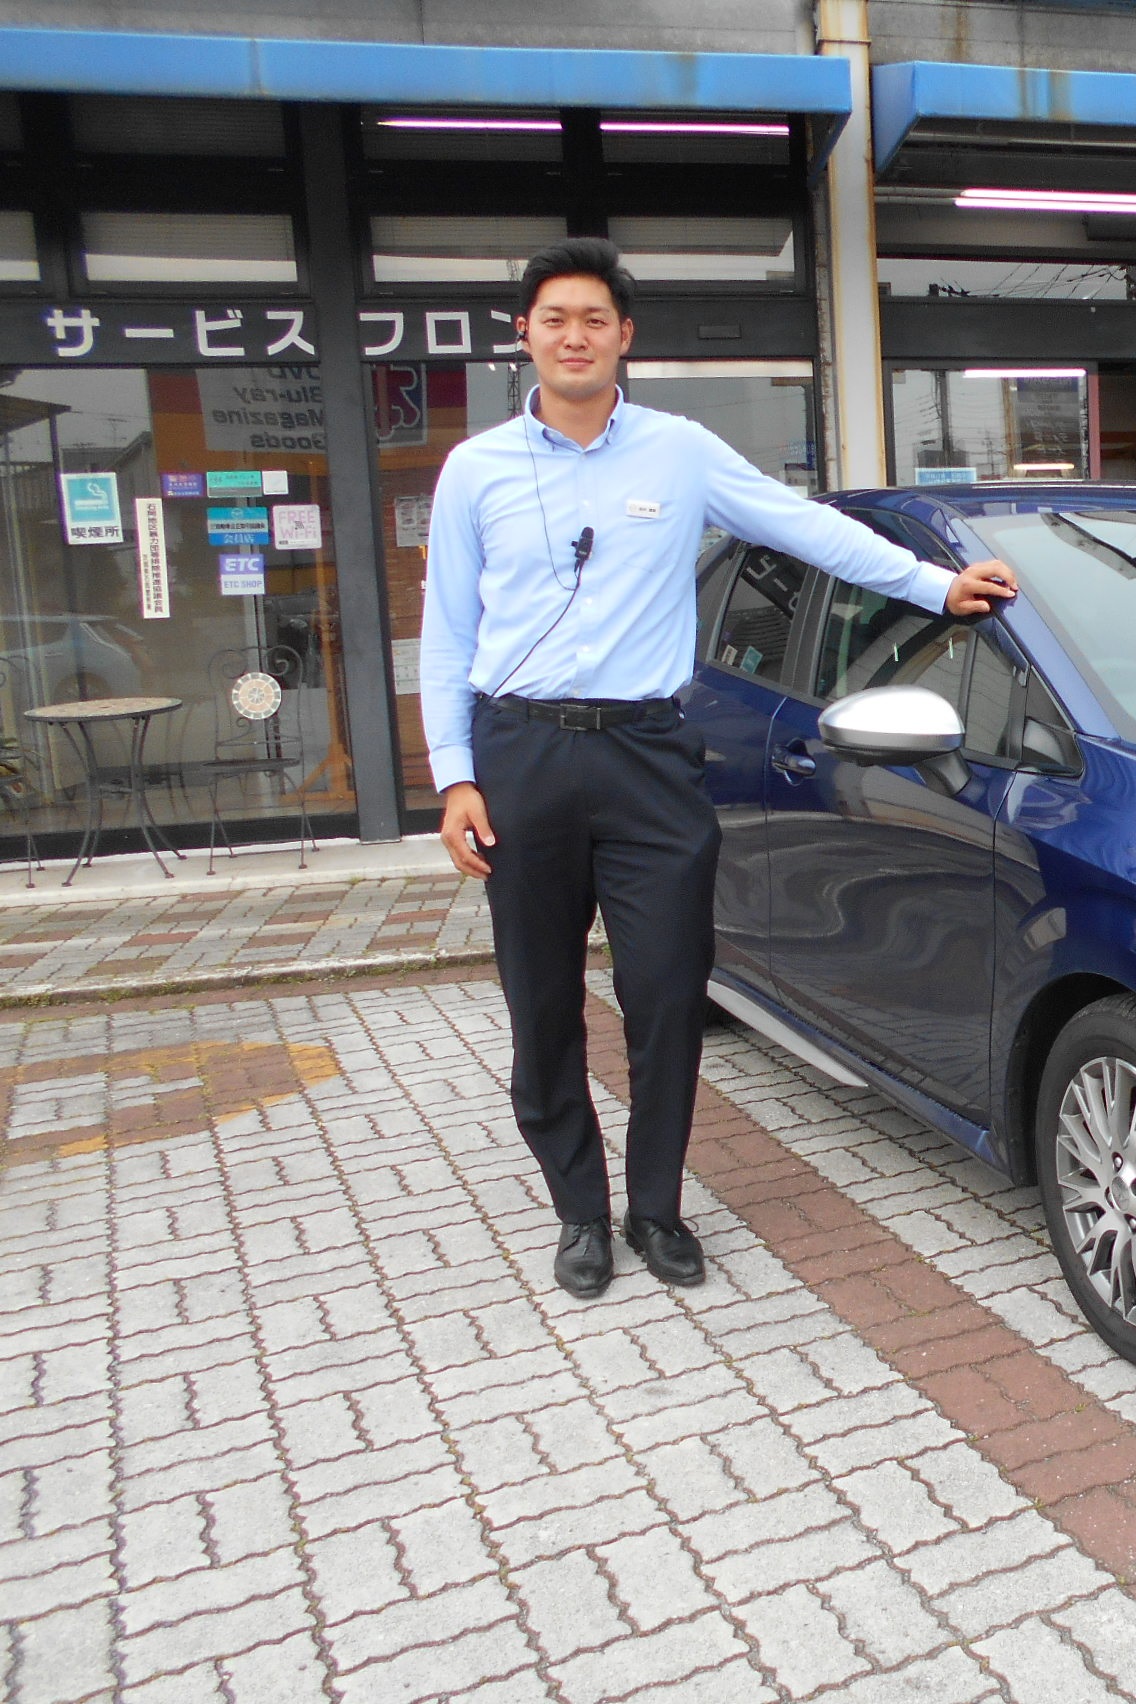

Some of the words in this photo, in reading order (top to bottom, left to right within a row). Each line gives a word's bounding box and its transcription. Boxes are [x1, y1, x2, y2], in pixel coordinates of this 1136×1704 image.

[46, 309, 315, 357] サービス
[279, 511, 315, 524] FREE
[71, 526, 119, 538] 喫煙所
[281, 527, 317, 539] Wi-Fi
[225, 558, 260, 571] ETC
